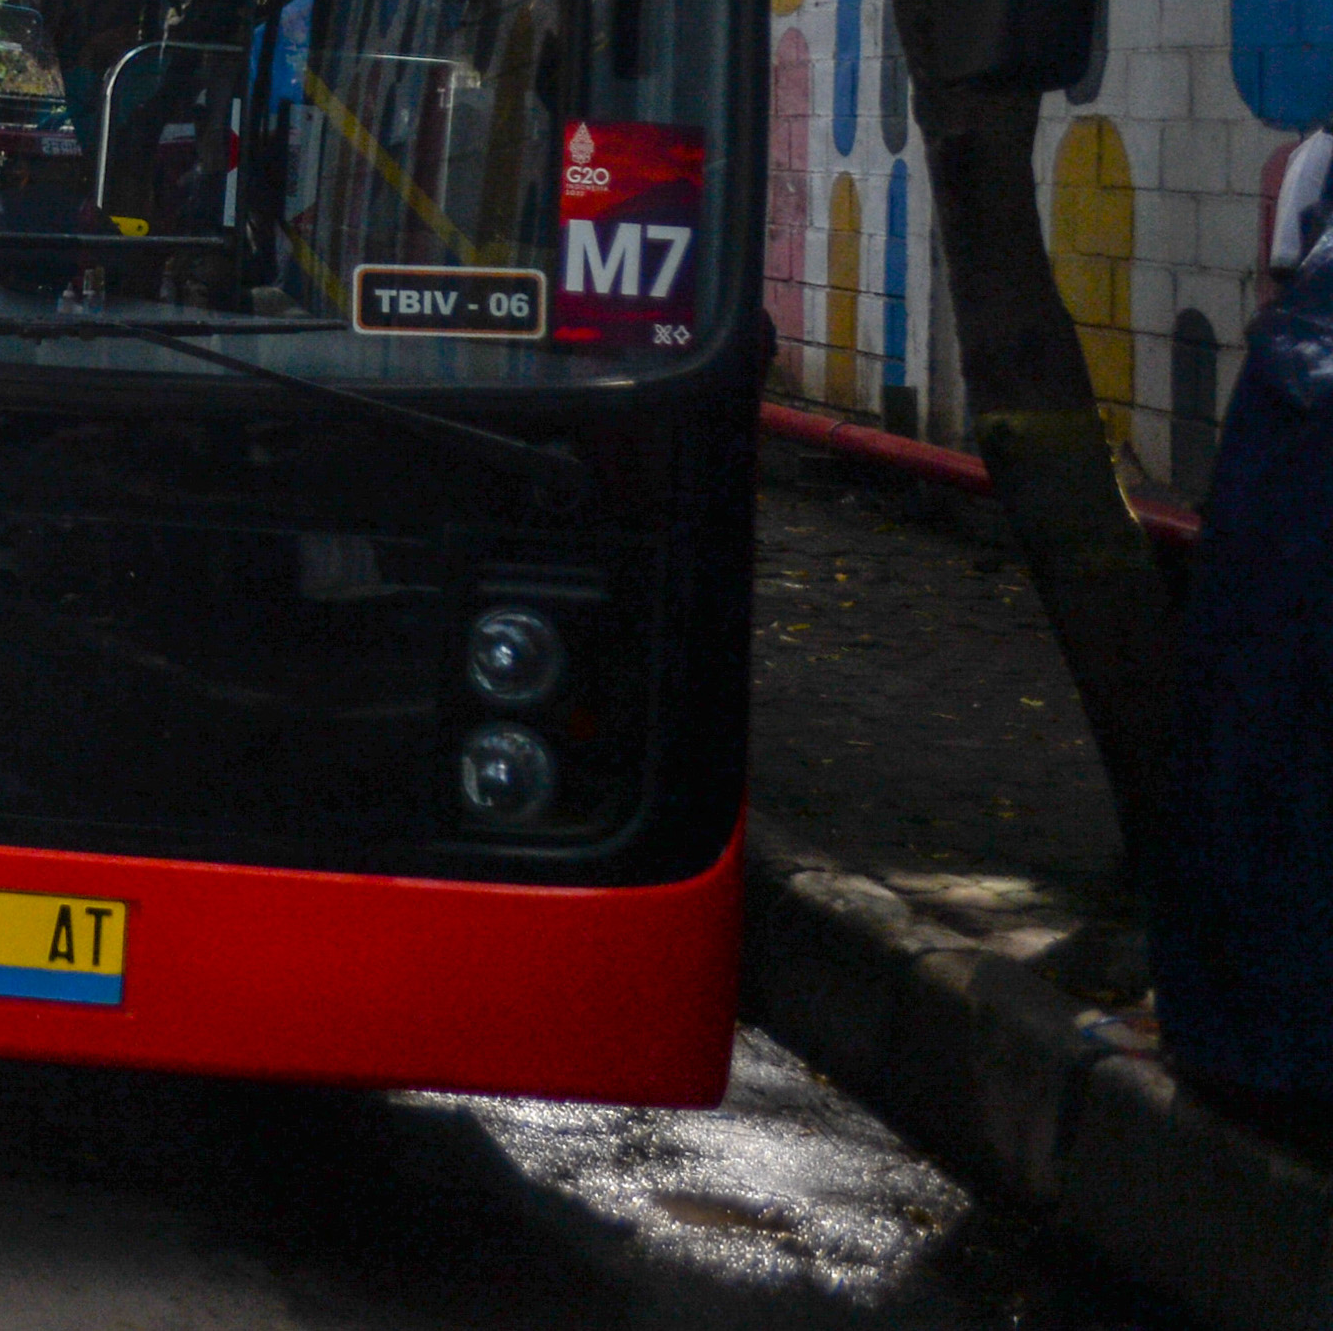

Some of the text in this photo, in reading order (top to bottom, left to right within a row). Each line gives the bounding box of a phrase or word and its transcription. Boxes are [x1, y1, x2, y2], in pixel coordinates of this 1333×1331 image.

[566, 166, 609, 185] G20
[565, 218, 692, 298] M7
[375, 289, 459, 317] TBIV
[489, 292, 530, 318] 06
[48, 904, 113, 967] AT
